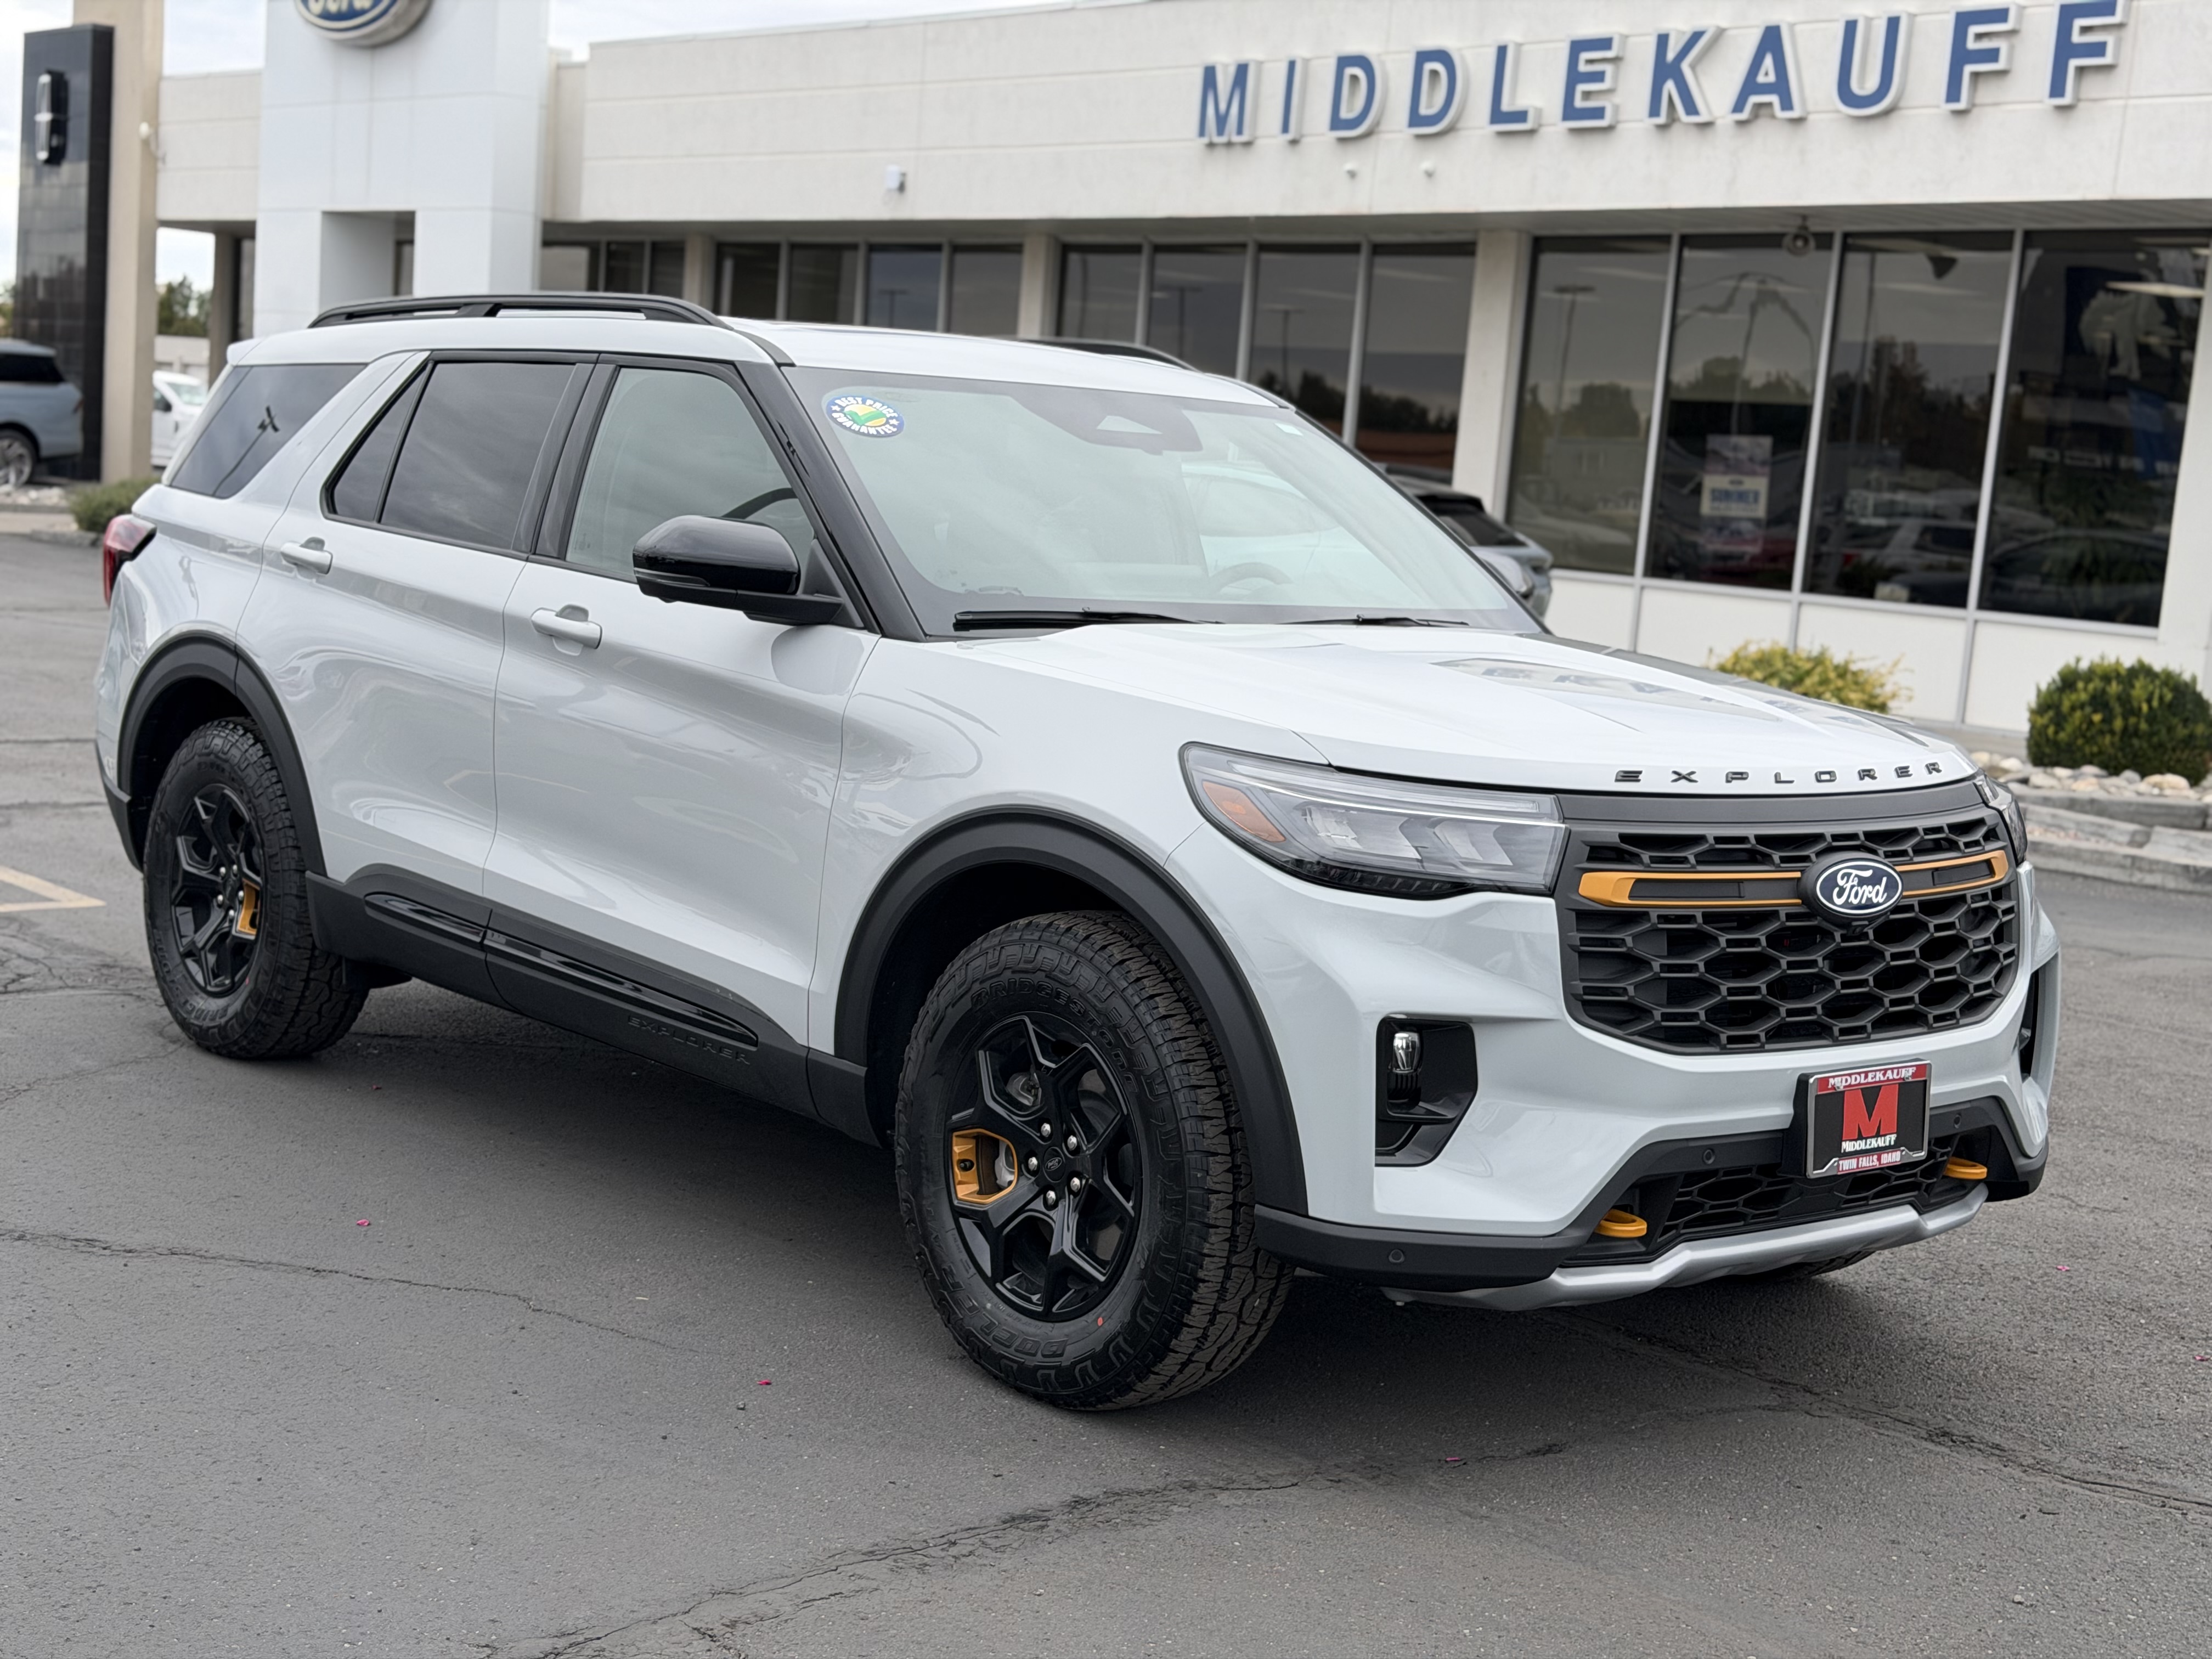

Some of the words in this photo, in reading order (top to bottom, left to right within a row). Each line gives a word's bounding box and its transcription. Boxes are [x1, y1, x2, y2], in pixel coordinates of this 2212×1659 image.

[1197, 0, 2126, 144] MIDDLEKAUFF
[834, 396, 864, 407] BEST
[865, 399, 899, 418] PRICE
[832, 412, 898, 435] GUARANTEE
[1614, 761, 1943, 783] EXPLORER
[1832, 868, 1887, 905] Ford
[628, 1015, 751, 1065] EXPLORER
[970, 977, 1139, 1093] BRIDGESTONE
[1827, 1066, 1916, 1089] MIDDLEKAUFF
[1842, 1084, 1899, 1141] M
[1841, 1133, 1897, 1153] MIDDLEKAUFF
[1839, 1159, 1857, 1171] TWIN
[1858, 1155, 1880, 1169] FALLS,
[1881, 1150, 1901, 1165] IDAHO
